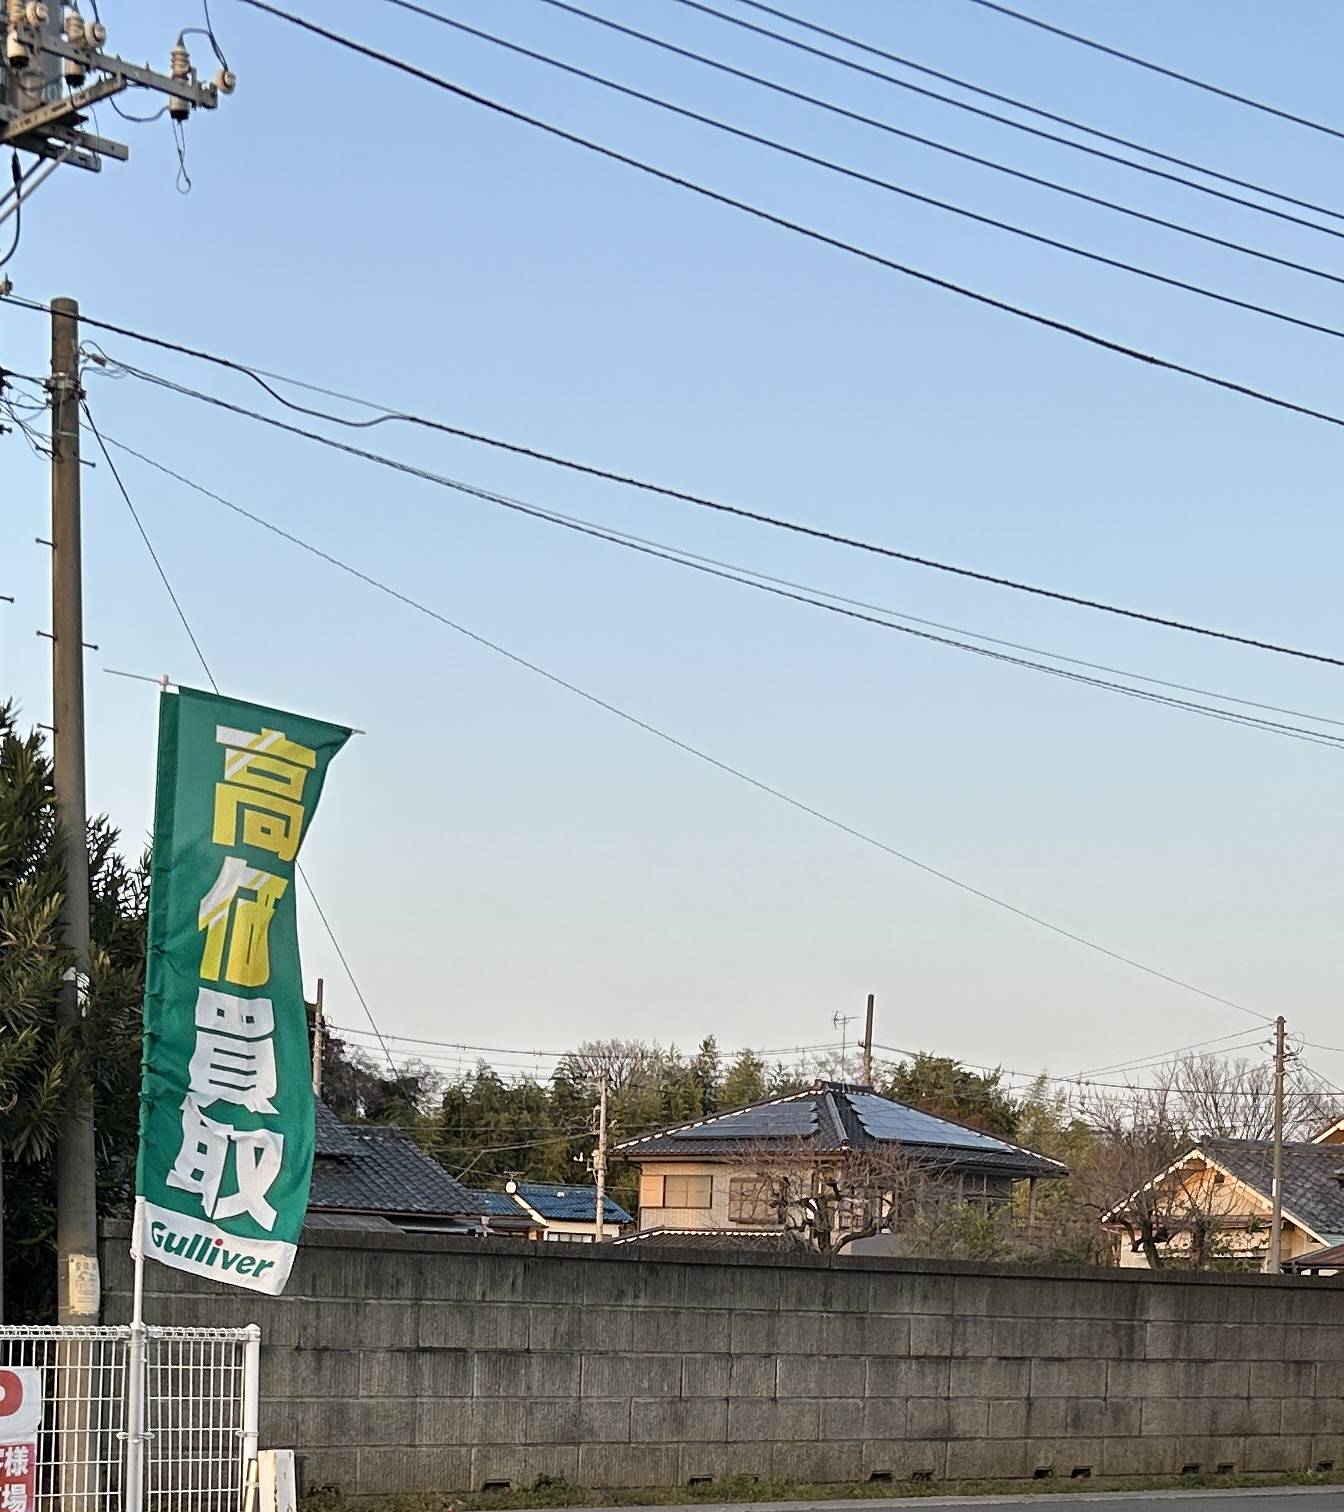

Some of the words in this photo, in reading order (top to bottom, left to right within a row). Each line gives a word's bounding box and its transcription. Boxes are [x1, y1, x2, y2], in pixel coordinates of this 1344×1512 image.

[165, 724, 317, 1232] 高価買取
[151, 1221, 274, 1278] Gulliver
